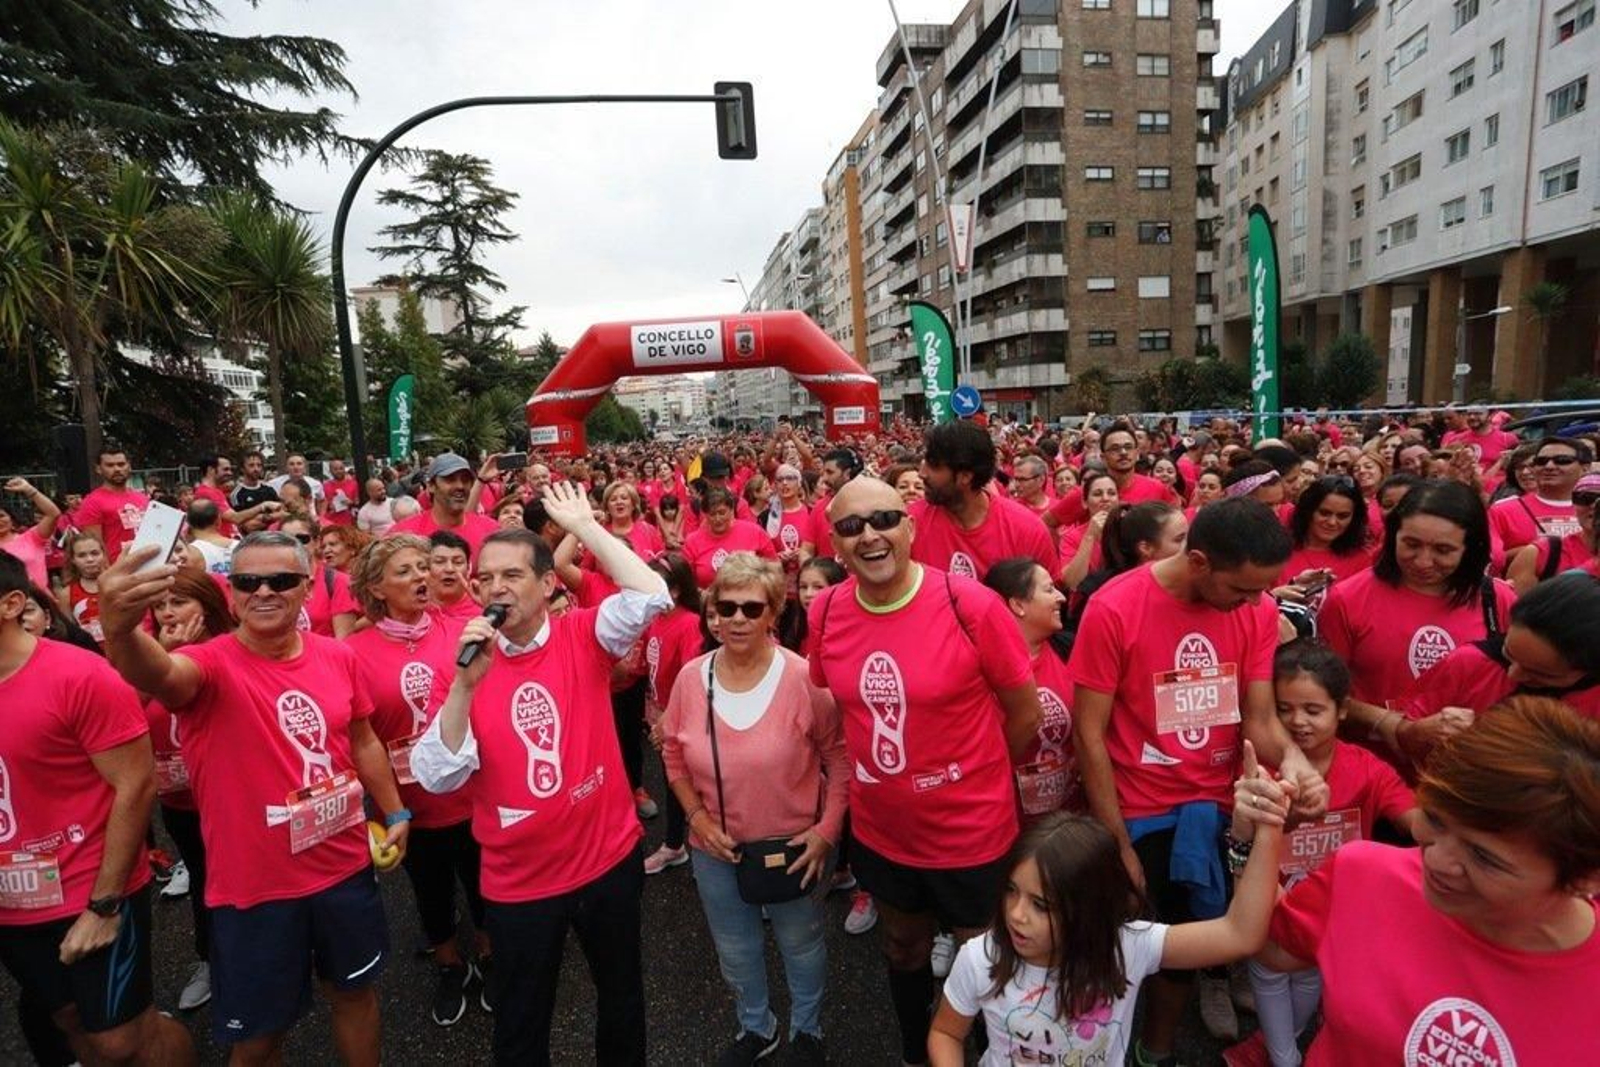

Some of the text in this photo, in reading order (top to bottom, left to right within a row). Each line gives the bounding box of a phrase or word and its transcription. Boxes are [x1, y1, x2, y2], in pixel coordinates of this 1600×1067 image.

[637, 328, 715, 344] CONCELLO
[647, 343, 707, 358] DE VIGO
[1425, 633, 1441, 645] VI
[1187, 641, 1202, 652] VI
[873, 660, 888, 673] VI
[1181, 659, 1211, 668] VIGO
[866, 679, 896, 690] VIGO
[521, 689, 538, 701] VI
[1175, 685, 1219, 713] 5129
[283, 697, 303, 710] VI
[518, 703, 549, 717] VIGO
[314, 793, 347, 825] 380
[1291, 831, 1342, 856] 5578
[1451, 1010, 1488, 1050] VI
[1015, 1030, 1052, 1045] VI
